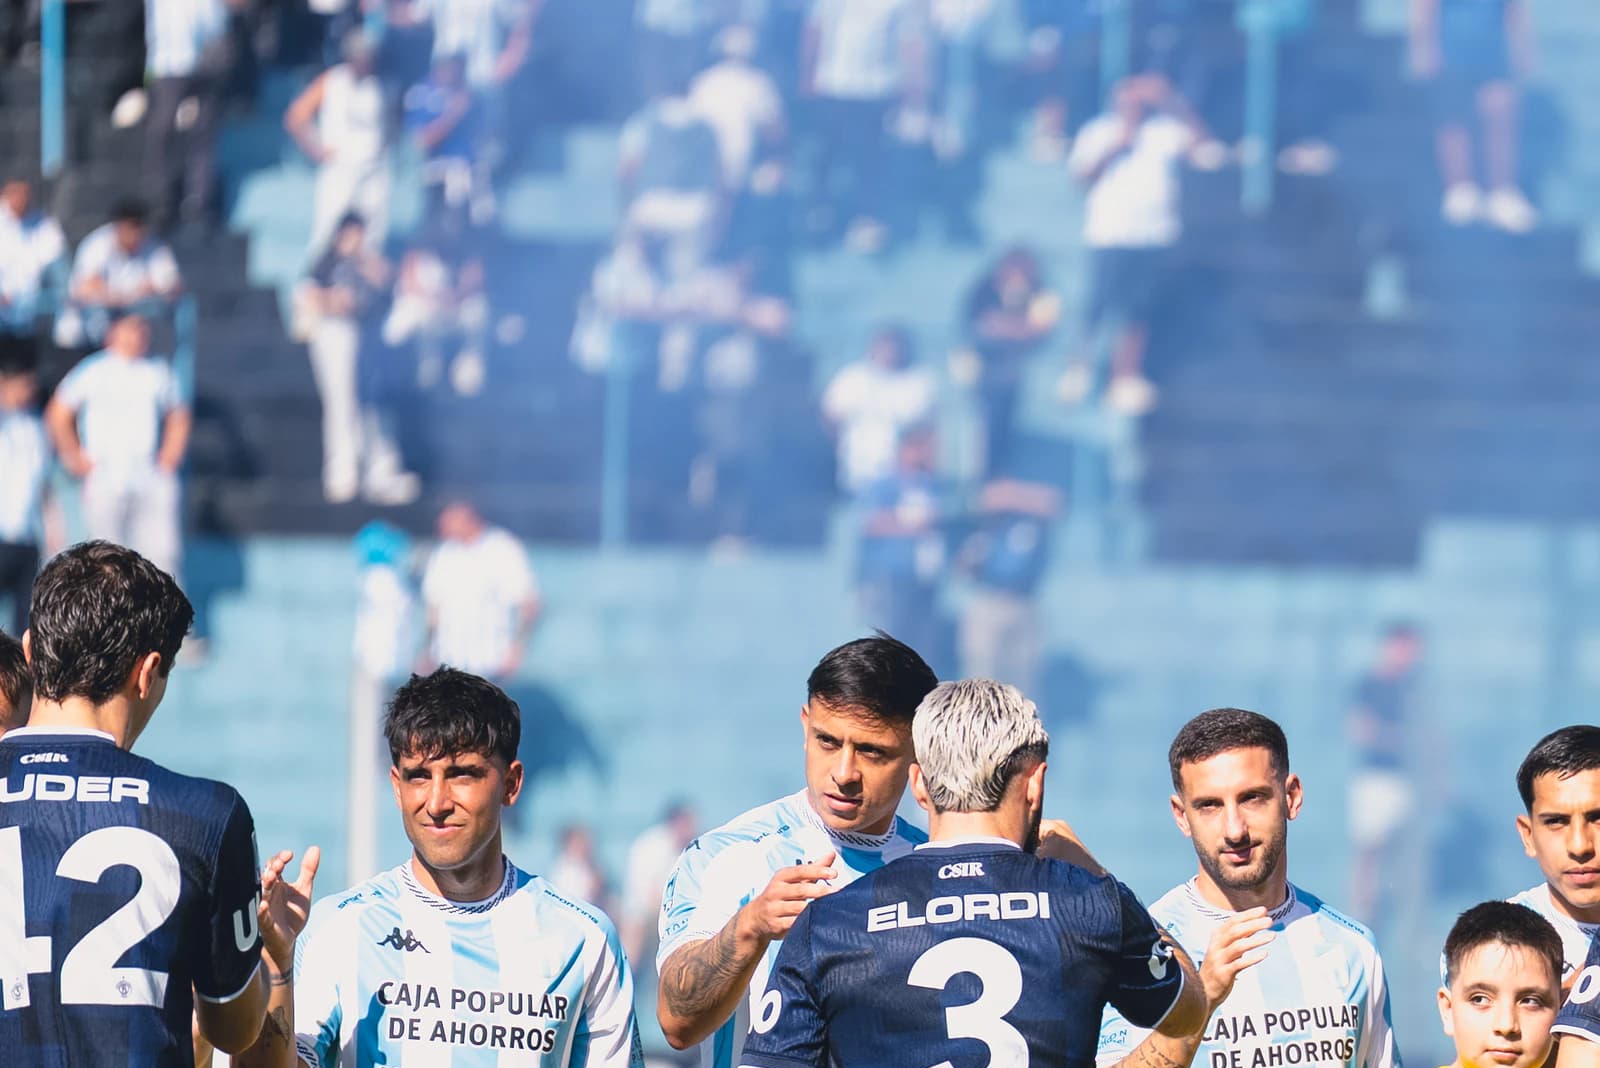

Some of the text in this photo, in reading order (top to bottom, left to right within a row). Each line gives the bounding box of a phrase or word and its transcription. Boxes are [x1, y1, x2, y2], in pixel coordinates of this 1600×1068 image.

[938, 862, 984, 879] CSIR
[867, 892, 1050, 932] ELORDI
[377, 982, 568, 1021] CAJA POPULAR
[389, 1017, 556, 1052] DE AHORROS
[1202, 1004, 1359, 1044] AJA POPULAR
[1251, 1038, 1354, 1068] AHORROS
